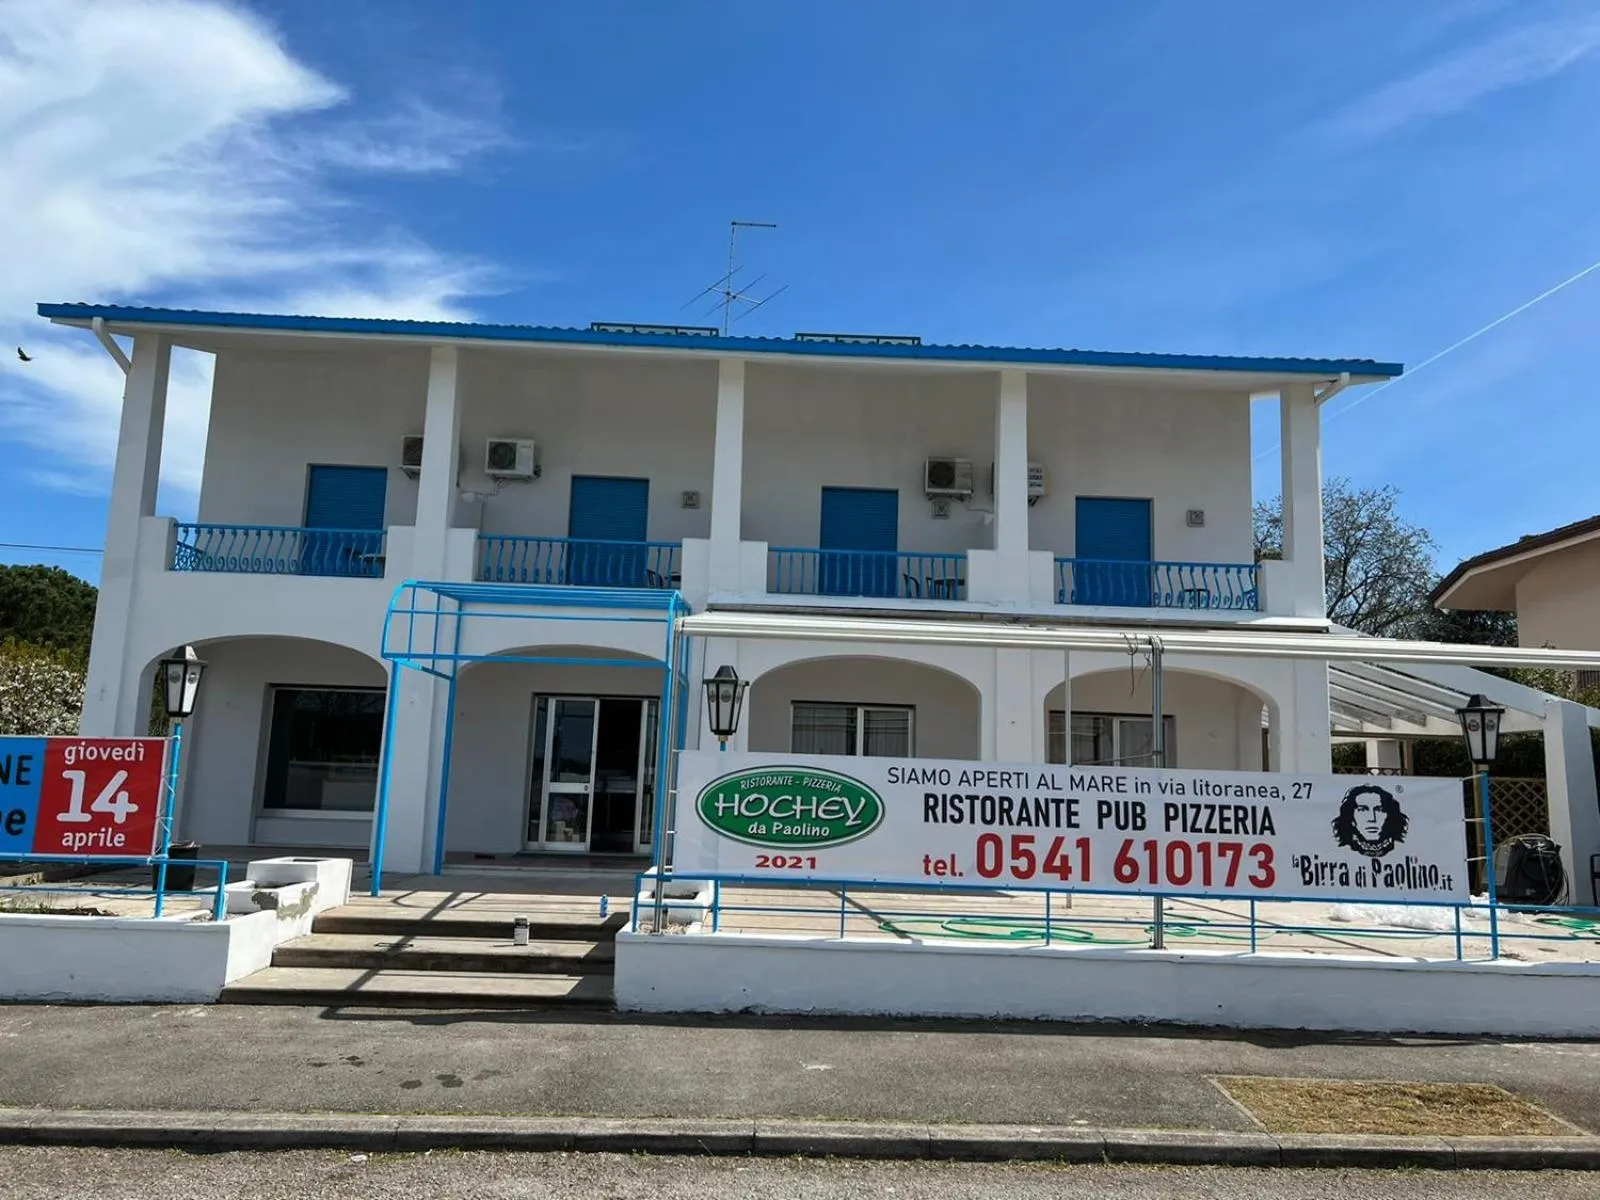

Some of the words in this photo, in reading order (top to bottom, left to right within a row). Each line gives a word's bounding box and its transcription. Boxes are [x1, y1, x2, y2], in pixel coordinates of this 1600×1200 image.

[64, 741, 144, 765] giovedì
[56, 769, 139, 824] 14
[739, 775, 794, 789] RISTORANTE
[802, 776, 842, 794] PIZZERIA
[887, 766, 951, 786] SIAMO
[958, 770, 1029, 789] APERTI
[1036, 773, 1062, 791] AL
[1070, 774, 1127, 793] MARE
[1134, 776, 1151, 794] in
[1157, 778, 1185, 796] via
[1193, 779, 1286, 801] litoranea,
[1291, 782, 1313, 800] 27
[714, 792, 866, 827] HOCHEY
[923, 792, 1080, 829] RISTORANTE
[1096, 800, 1147, 832] PUB
[1164, 802, 1277, 836] PIZZERIA
[61, 827, 126, 851] aprile
[747, 821, 767, 835] da
[771, 823, 831, 837] Paolino
[755, 855, 817, 870] 2021
[922, 852, 964, 878] tel.
[976, 832, 1091, 882] 0541
[1113, 836, 1277, 889] 610173
[1300, 854, 1350, 888] Birra
[1355, 866, 1367, 888] di
